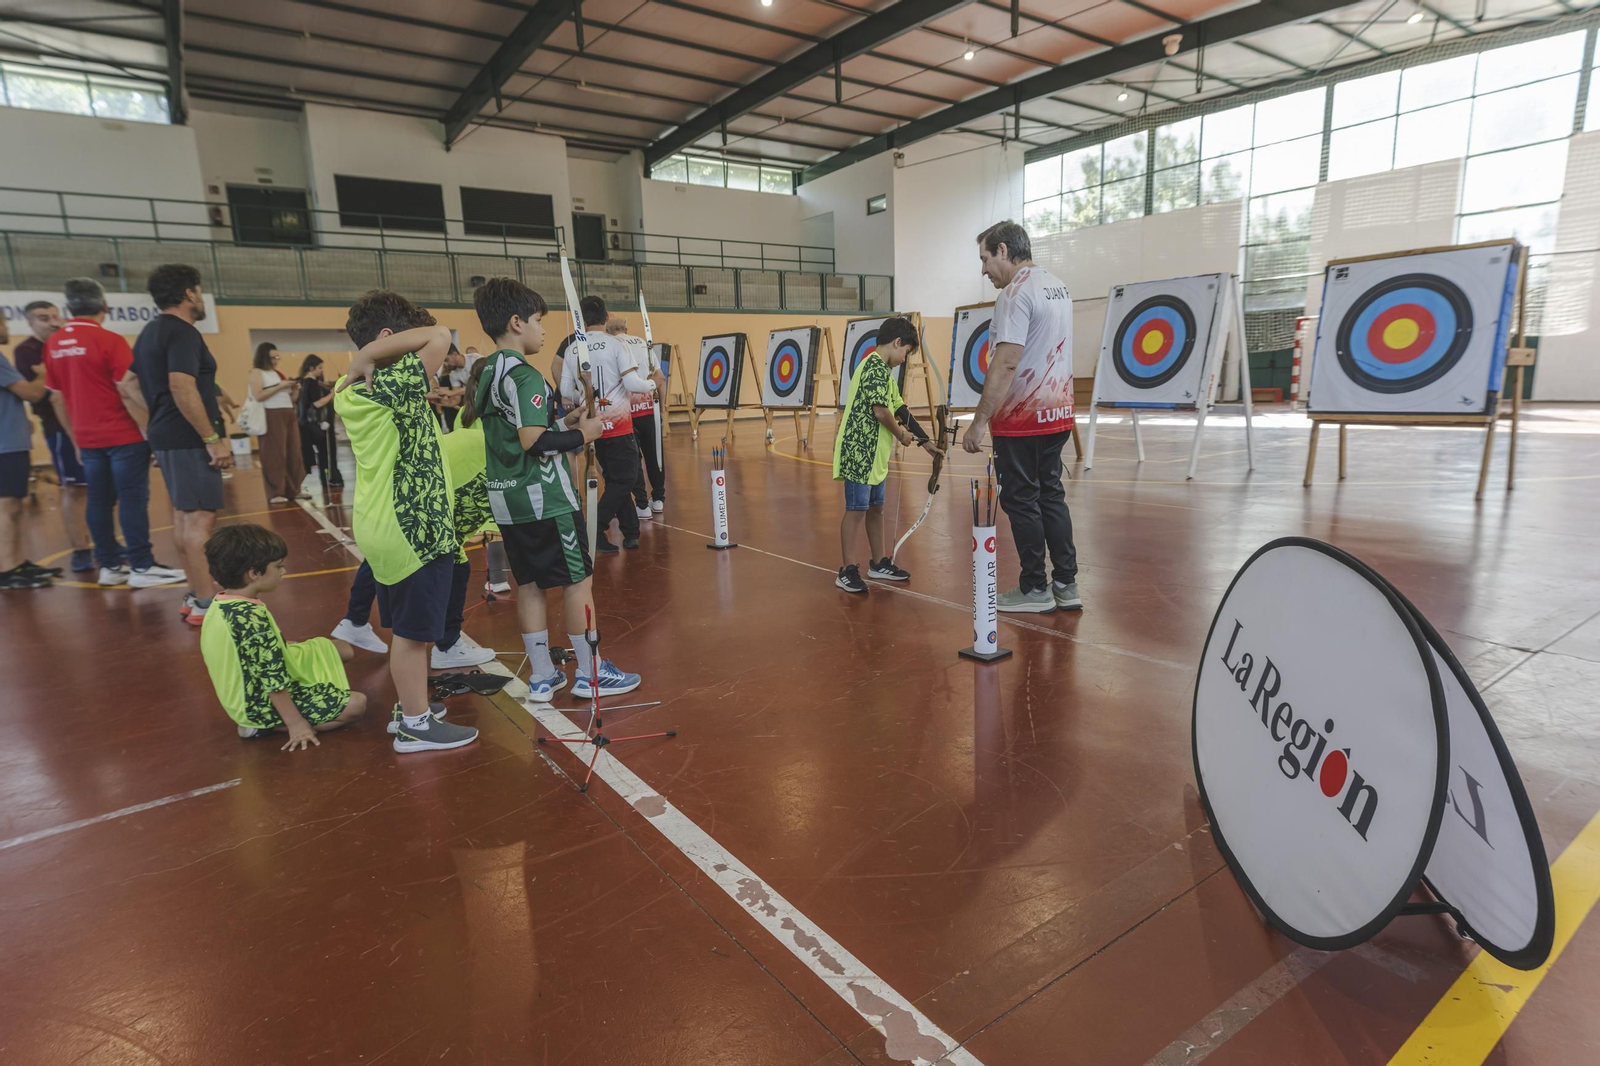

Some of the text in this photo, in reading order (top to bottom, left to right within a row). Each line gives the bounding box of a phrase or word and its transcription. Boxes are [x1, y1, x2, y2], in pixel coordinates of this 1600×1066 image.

[1043, 287, 1065, 300] JUAN
[572, 341, 606, 356] CLOS
[718, 490, 727, 528] LUMELAR
[988, 539, 996, 550] 4
[988, 560, 997, 623] LUMELAR
[1221, 618, 1379, 842] La Región
